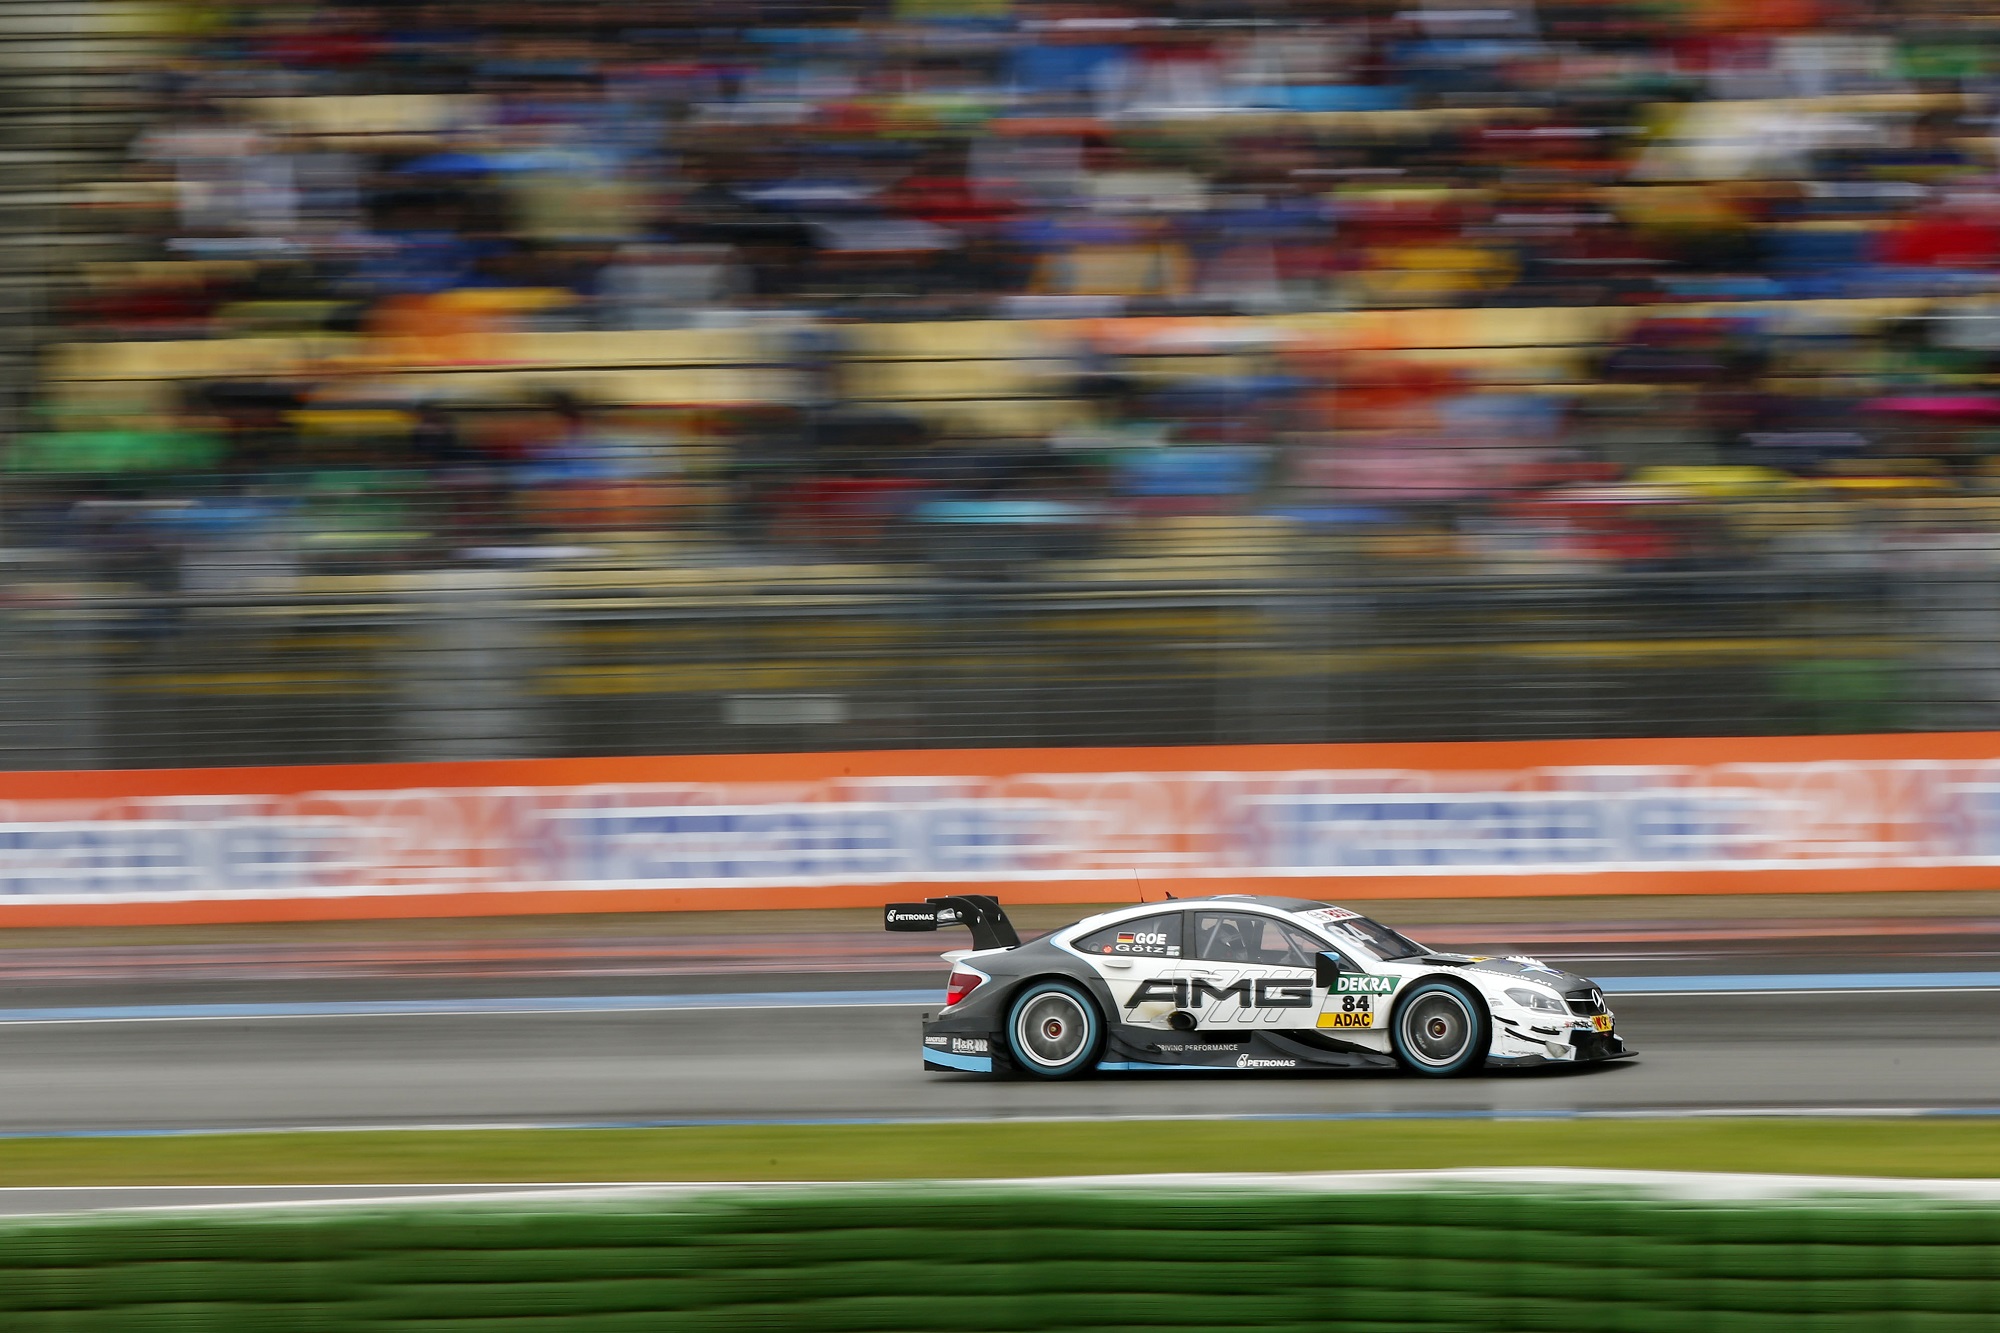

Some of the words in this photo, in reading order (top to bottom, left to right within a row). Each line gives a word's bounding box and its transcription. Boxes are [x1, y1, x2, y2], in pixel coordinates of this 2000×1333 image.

[895, 913, 935, 921] PETRONAS
[1135, 932, 1167, 945] GOE
[1327, 922, 1379, 948] 84
[1115, 944, 1164, 953] Götz
[1337, 977, 1392, 992] DEKRA
[1533, 979, 1553, 987] Art
[1123, 977, 1314, 1009] AMG
[1342, 995, 1370, 1012] 84
[1333, 1013, 1370, 1027] ADAC
[952, 1037, 974, 1050] H&R
[1246, 1059, 1296, 1067] PETRONAS
